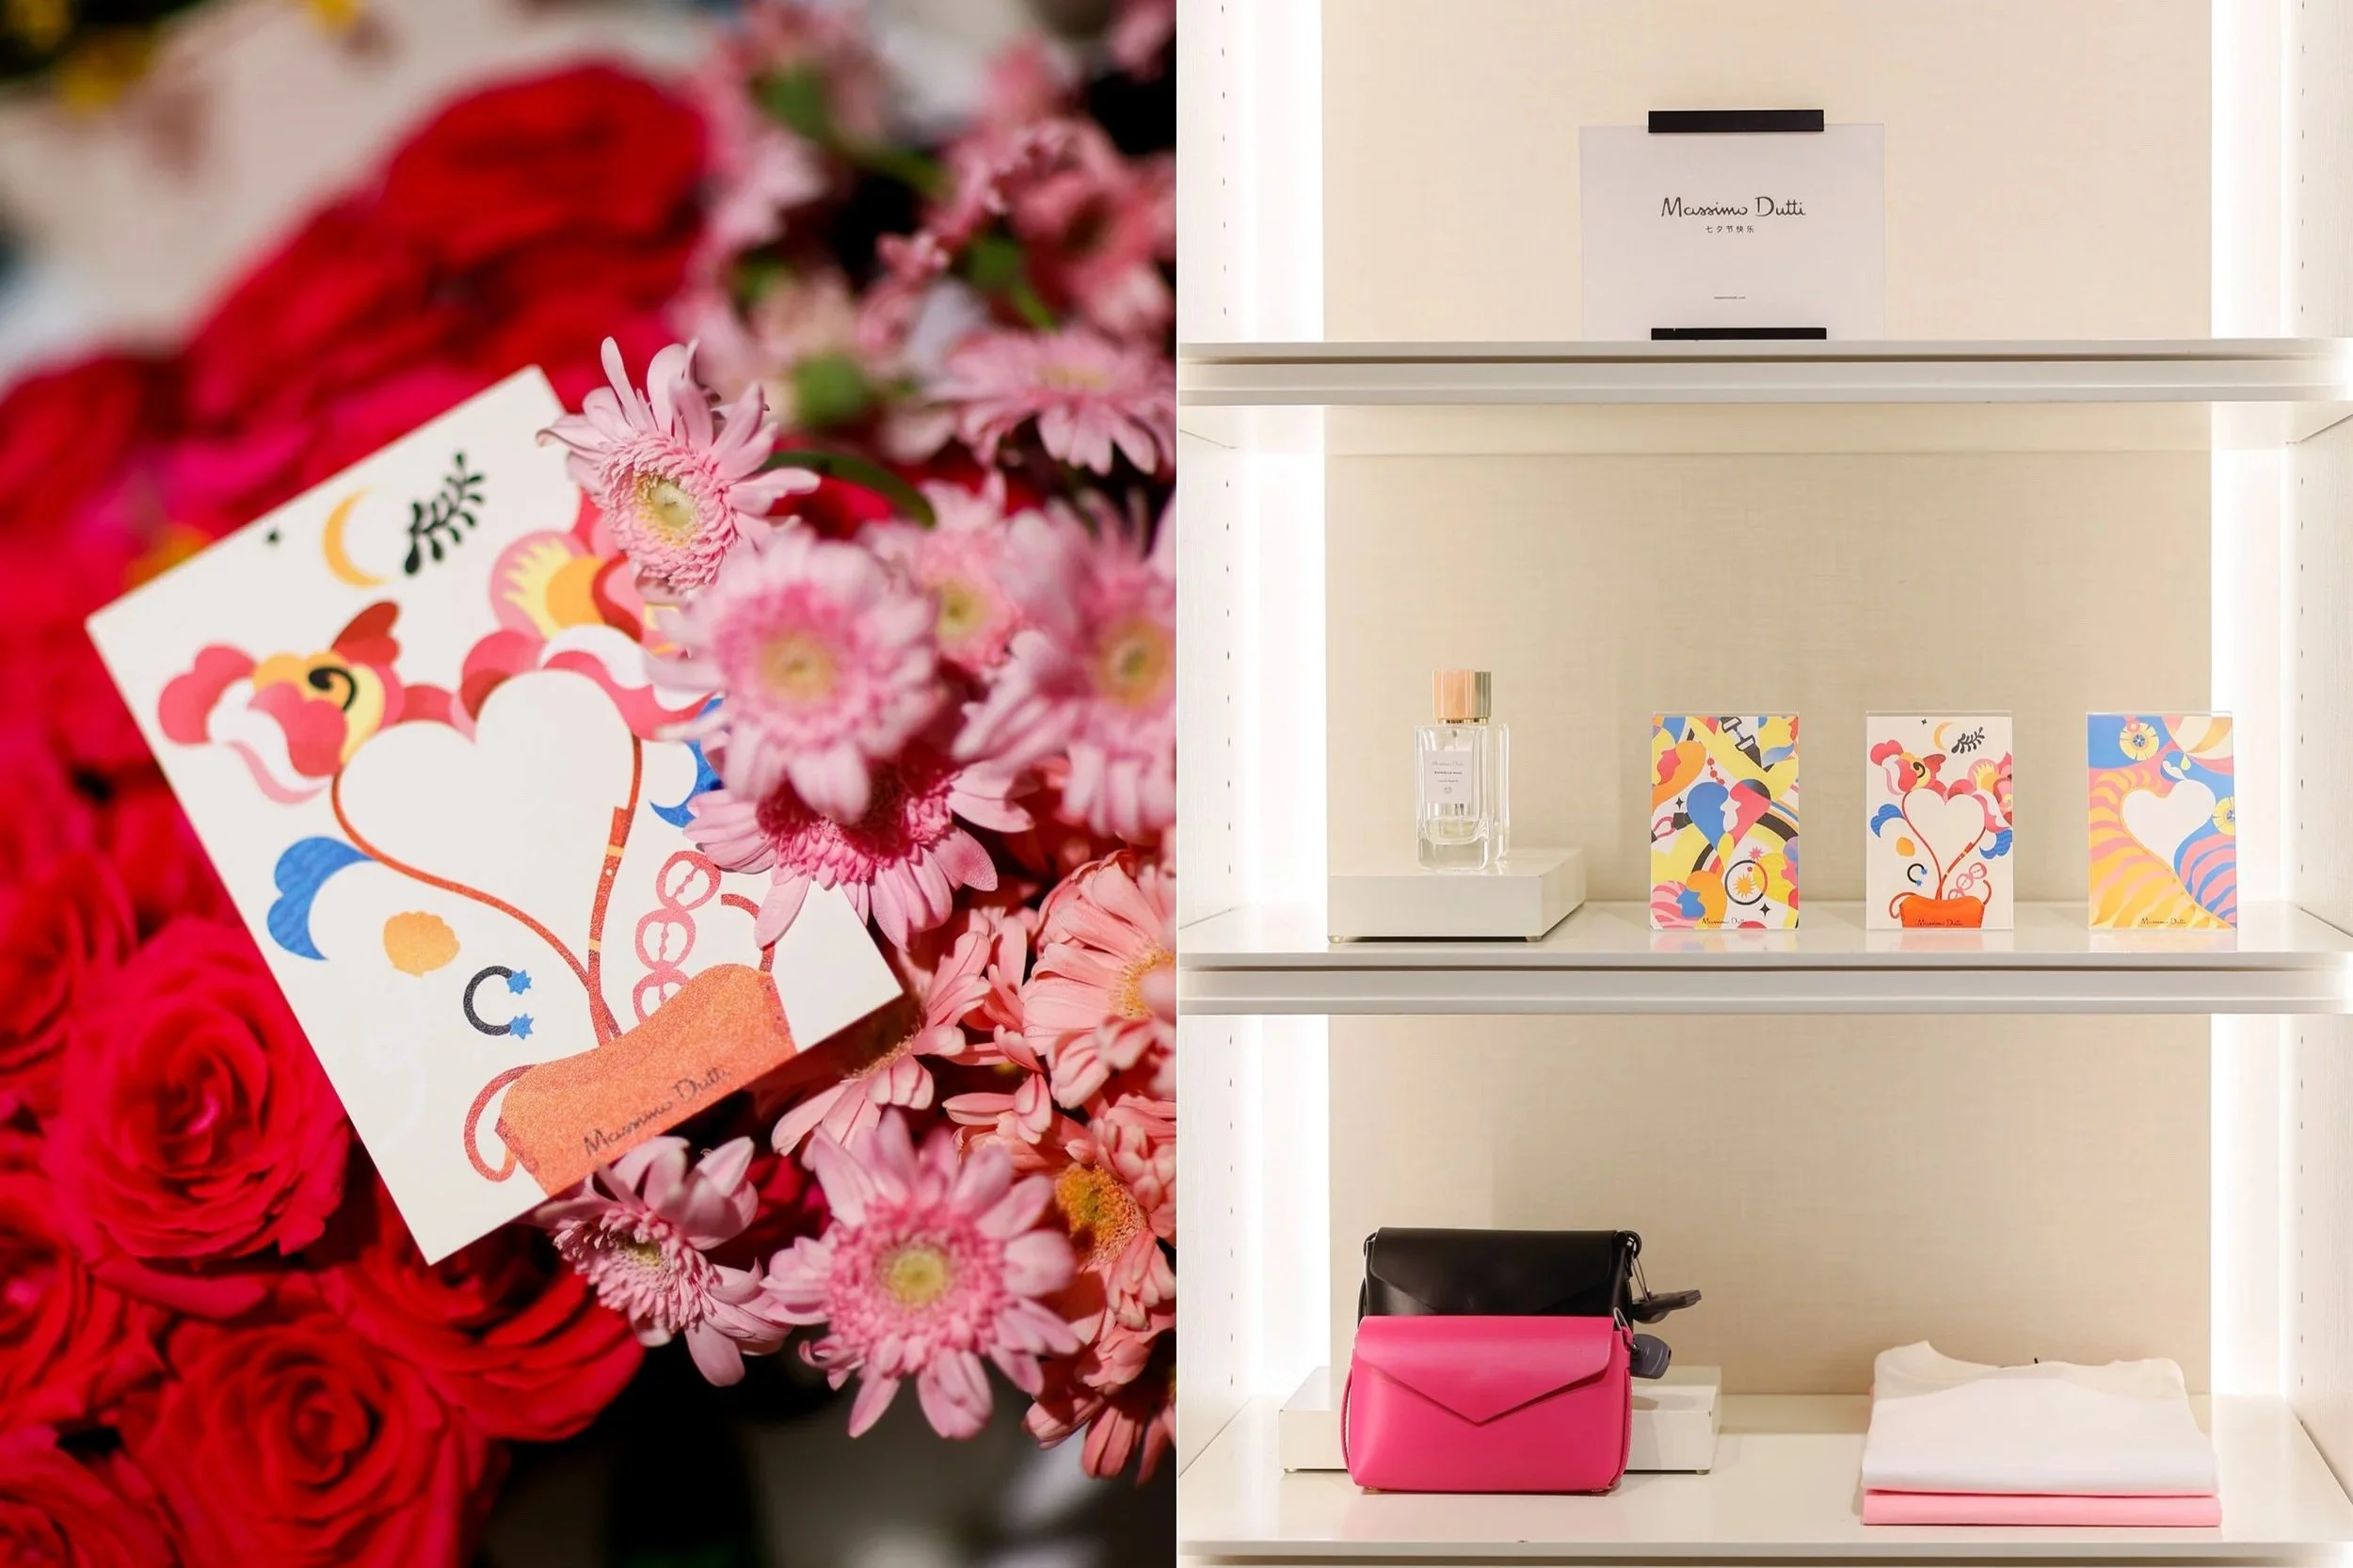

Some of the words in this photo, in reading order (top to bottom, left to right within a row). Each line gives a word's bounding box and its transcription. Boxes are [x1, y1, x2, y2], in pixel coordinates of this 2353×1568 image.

[1661, 197, 1748, 217] Massimo
[1754, 196, 1806, 217] Dutti
[1705, 225, 1754, 233] 七夕节快乐
[584, 1101, 673, 1156] Massimo
[673, 1066, 730, 1101] Dutti
